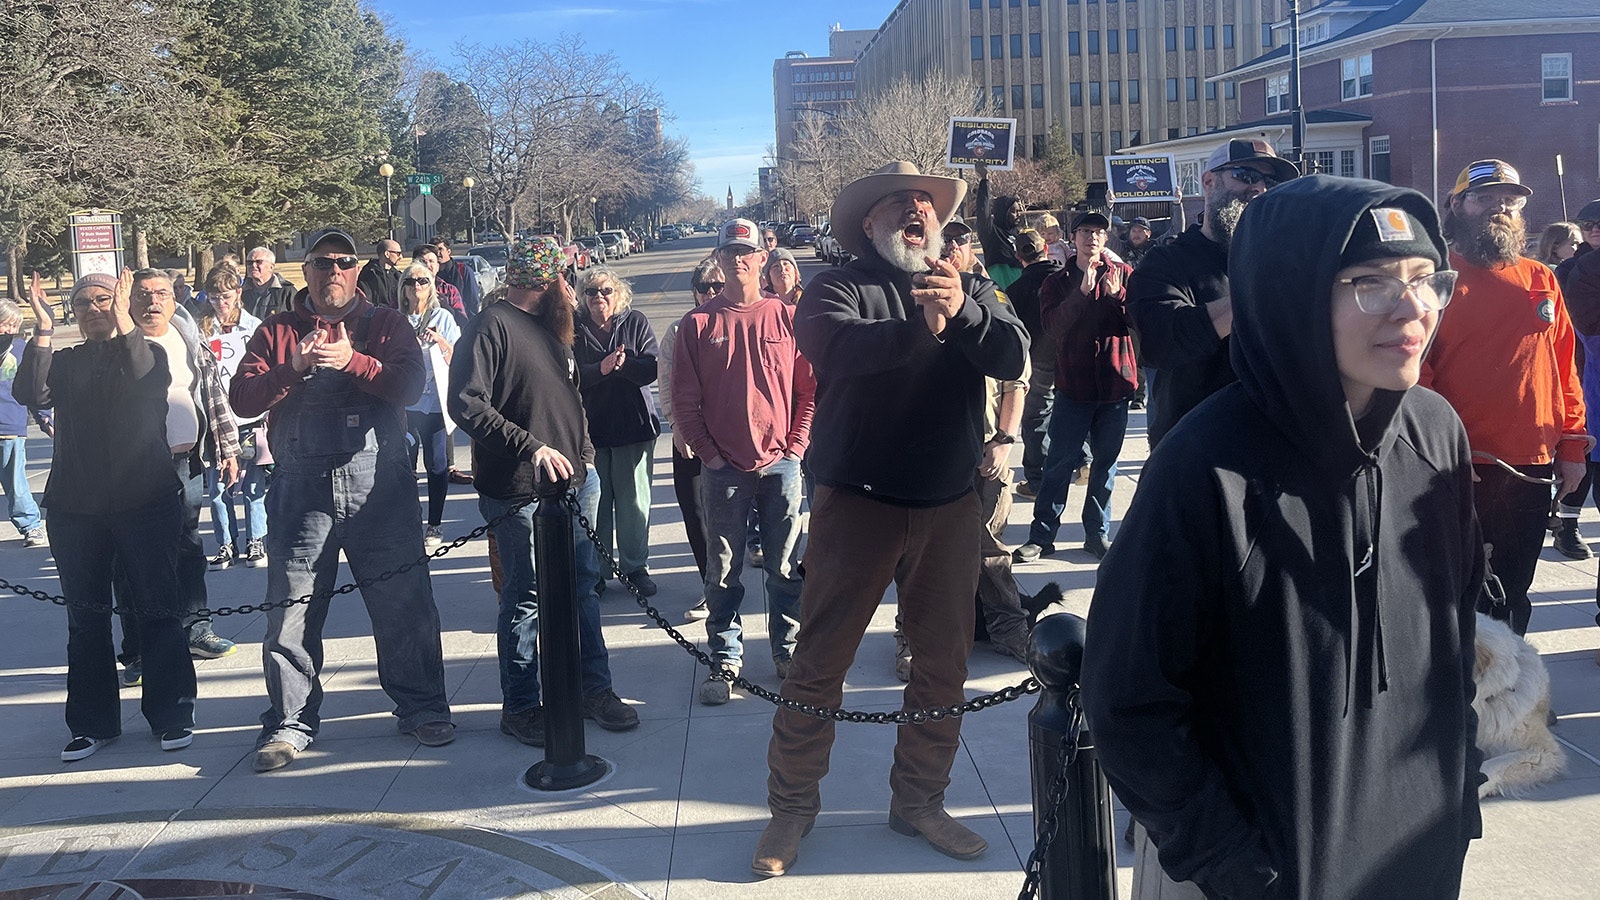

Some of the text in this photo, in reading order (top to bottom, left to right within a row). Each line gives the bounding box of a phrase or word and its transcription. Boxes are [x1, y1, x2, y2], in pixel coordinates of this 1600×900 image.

[955, 121, 1009, 129] RESILIENCE
[967, 129, 995, 140] COLORADO
[1111, 158, 1168, 166] RESILIENCE
[1126, 165, 1155, 174] COLORADO
[415, 175, 430, 183] 24th
[1115, 190, 1171, 198] SOLIDARITY
